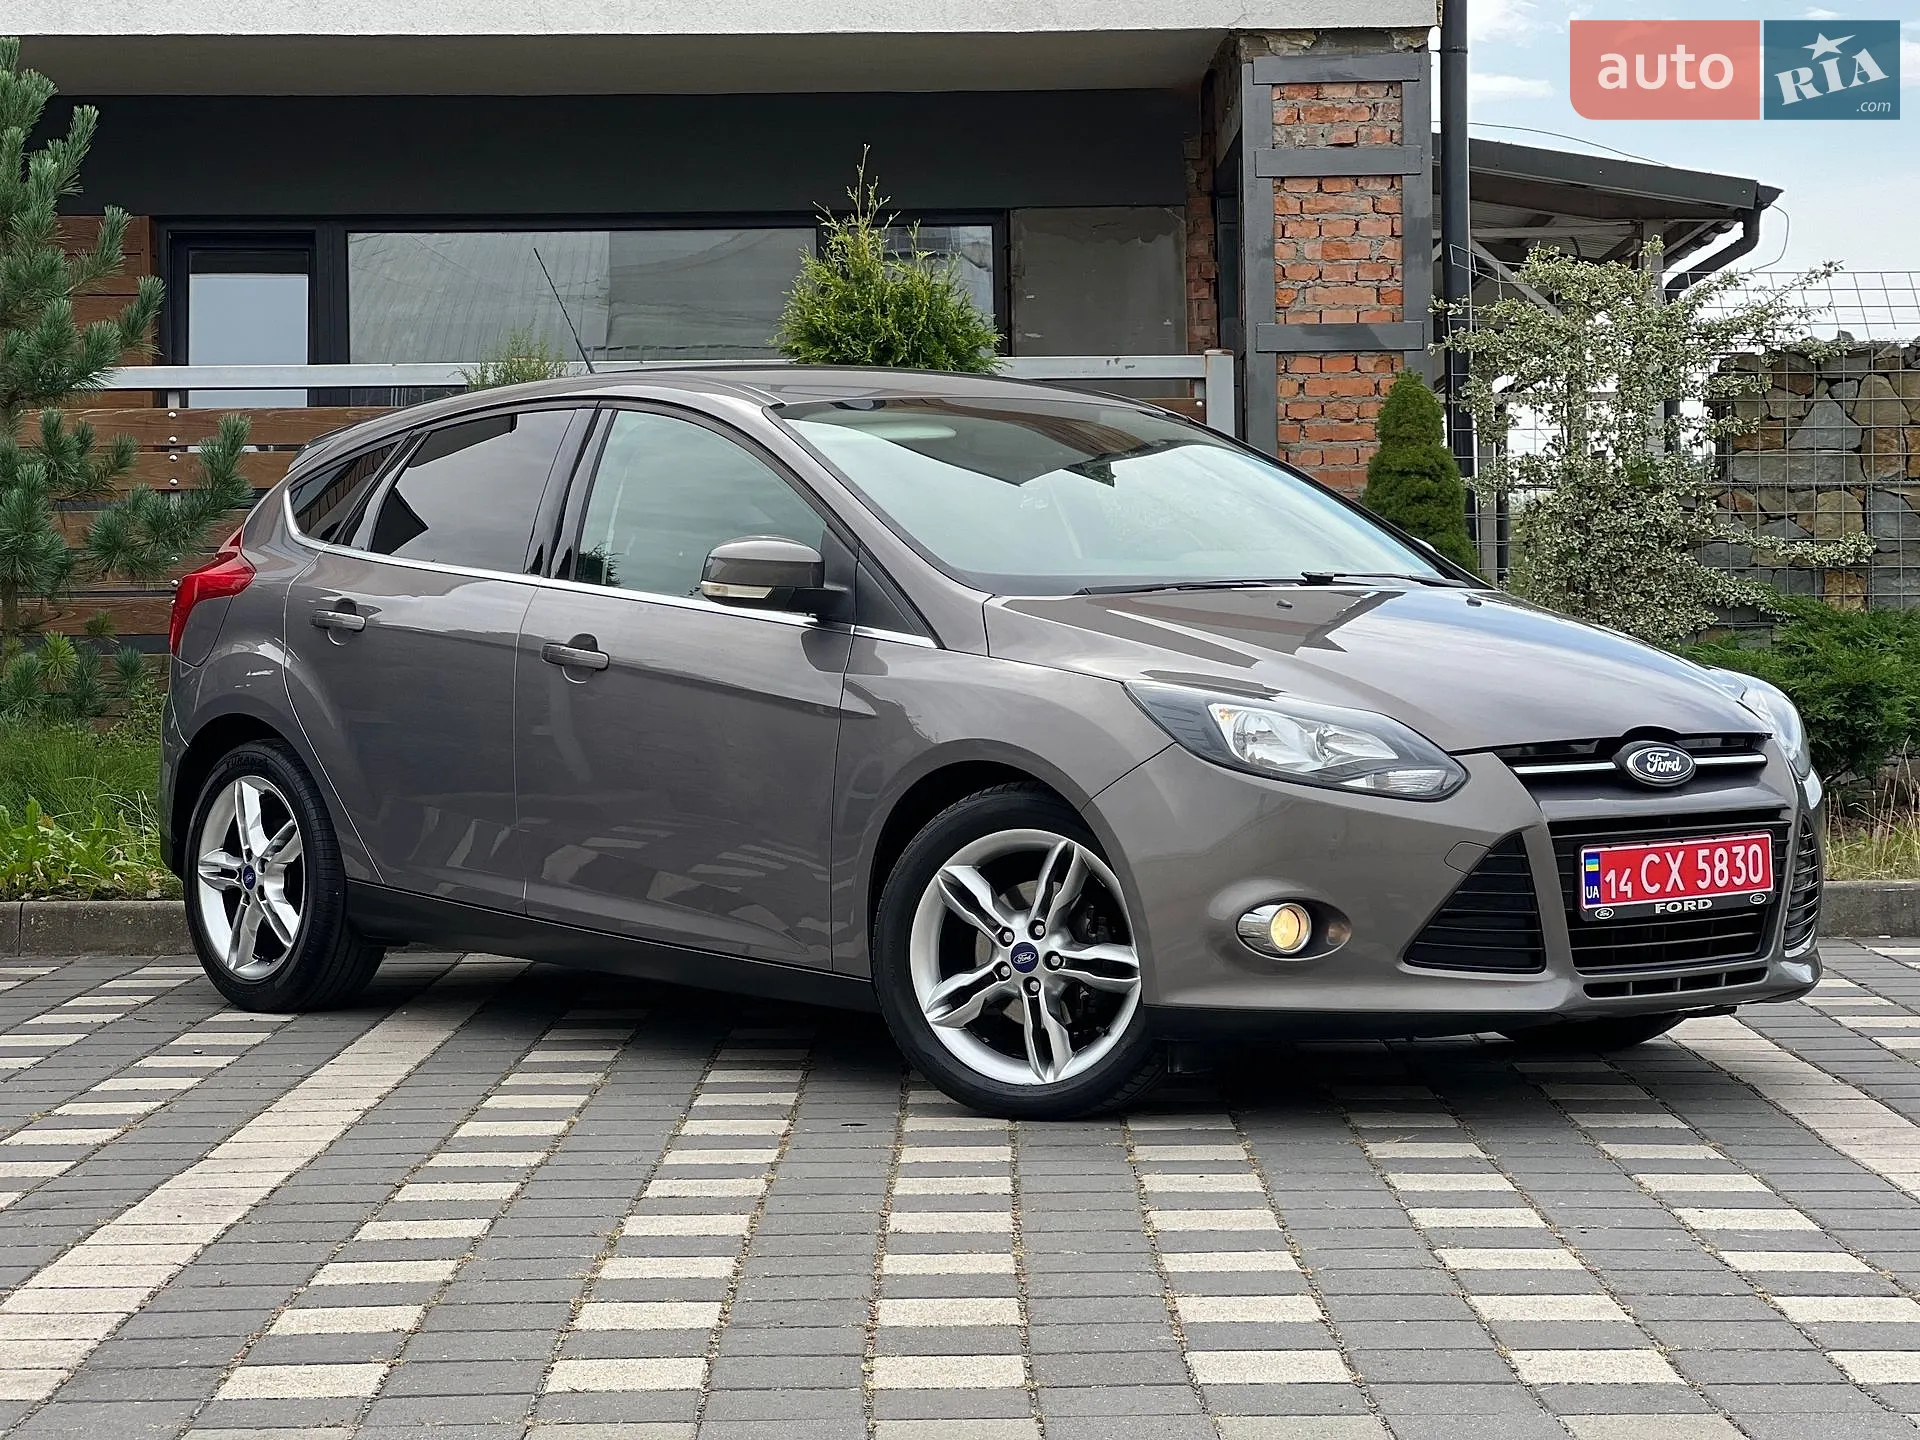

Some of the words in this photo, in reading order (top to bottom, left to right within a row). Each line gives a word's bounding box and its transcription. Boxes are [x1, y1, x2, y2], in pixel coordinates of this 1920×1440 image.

[1646, 752, 1682, 773] Ford
[1604, 868, 1633, 899] 14
[1640, 850, 1685, 894] CX
[1696, 843, 1764, 890] 5830
[1585, 886, 1600, 899] UA
[1655, 899, 1713, 914] FORD
